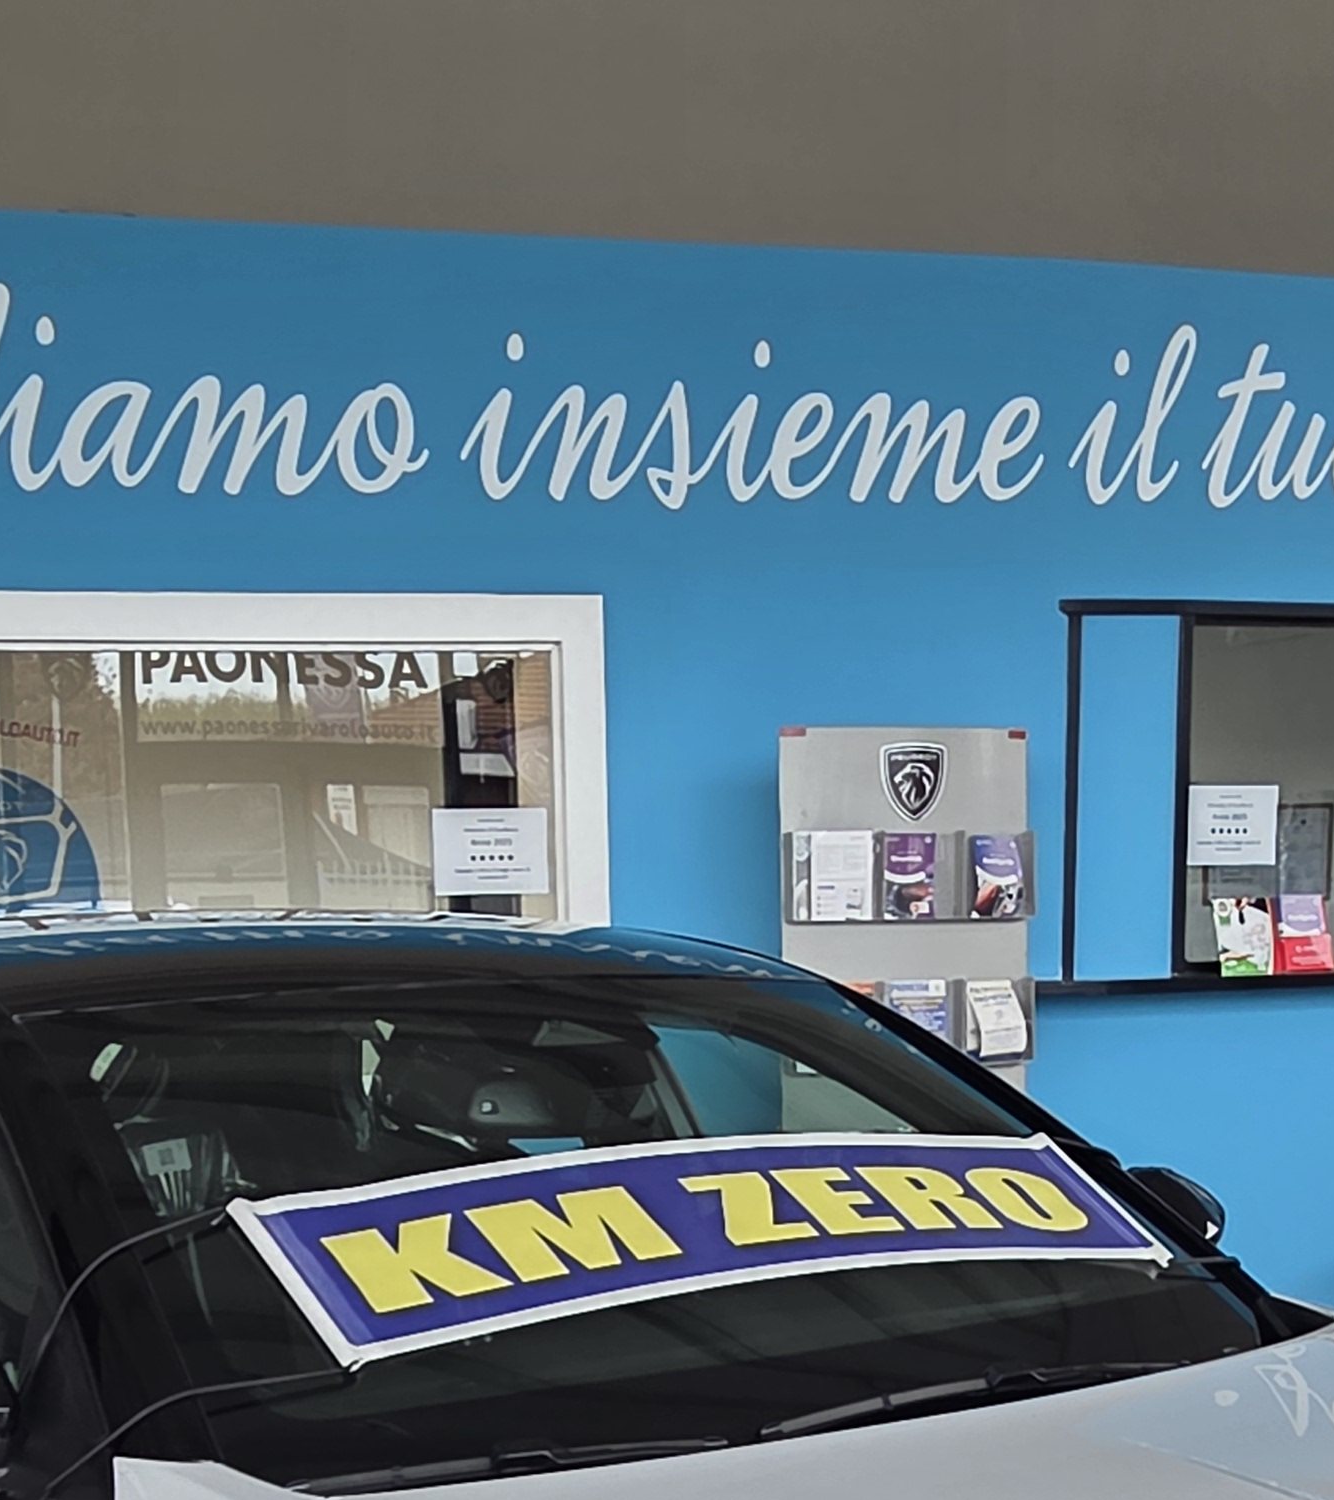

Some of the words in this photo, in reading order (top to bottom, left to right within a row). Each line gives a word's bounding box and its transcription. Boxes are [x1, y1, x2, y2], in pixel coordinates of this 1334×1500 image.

[460, 332, 1044, 510] insieme
[1069, 324, 1198, 506] il
[141, 650, 429, 689] PAONESSA
[319, 1186, 684, 1314] KM
[678, 1165, 1090, 1246] ZERO
